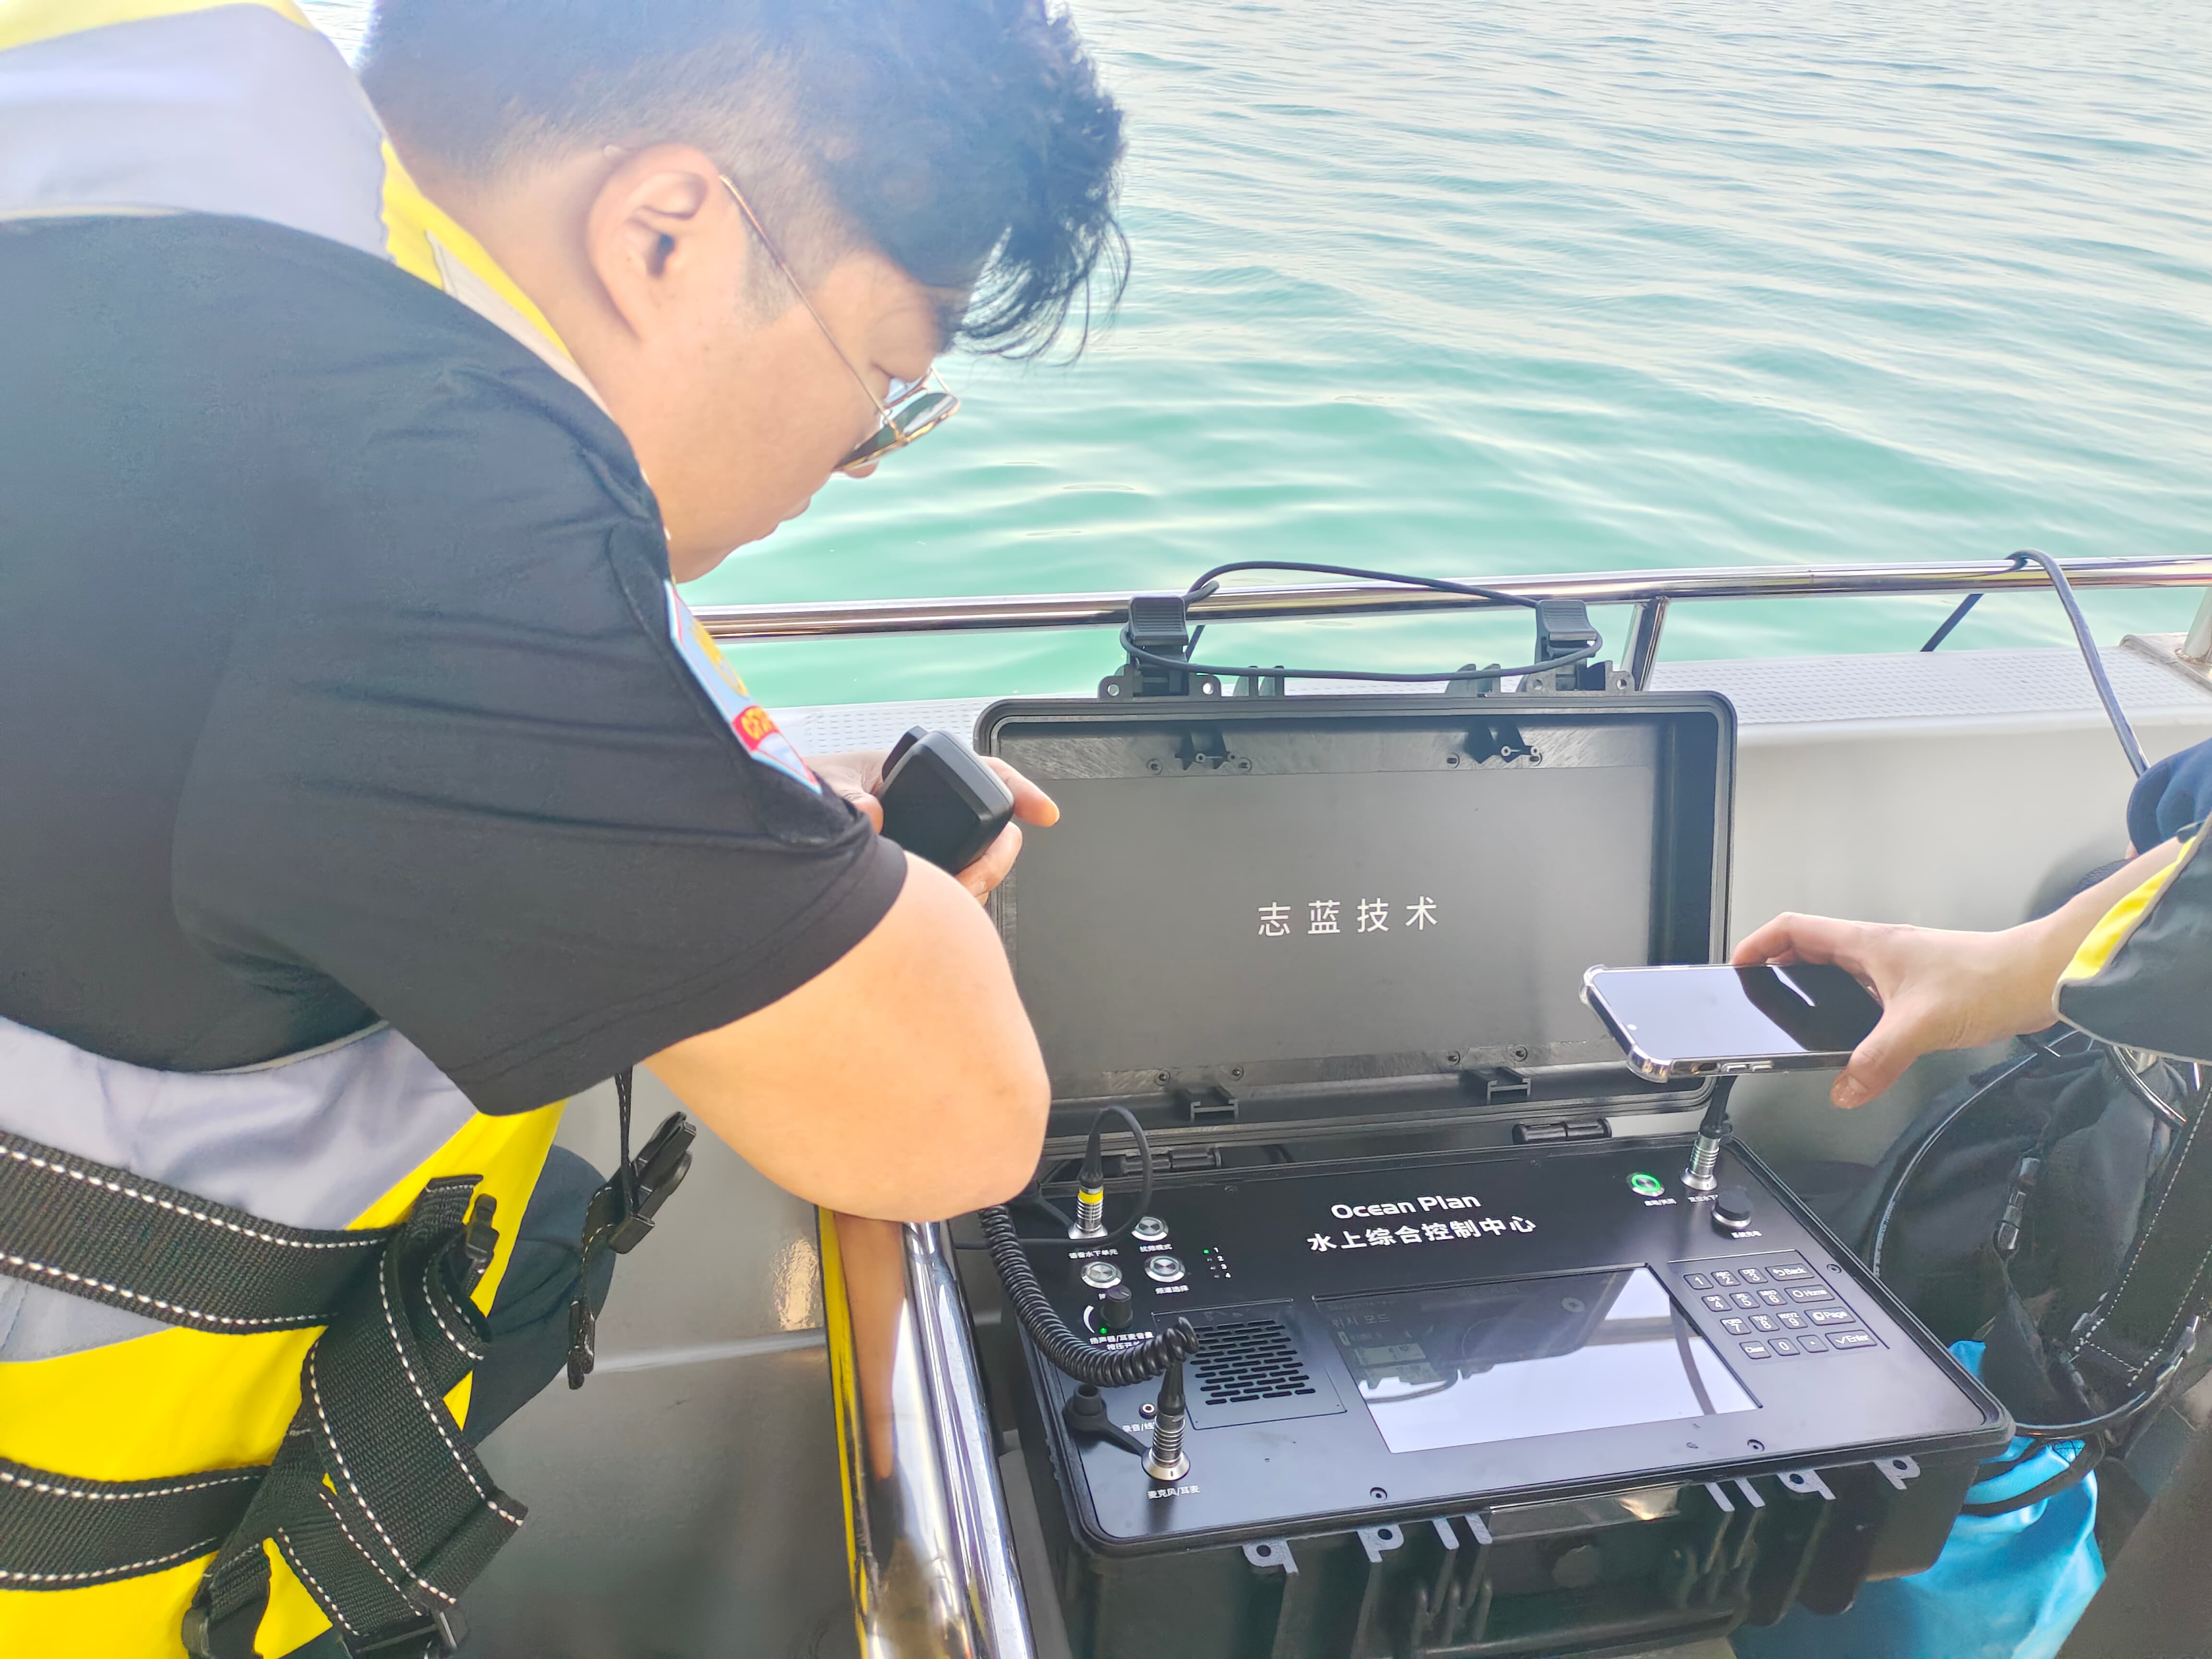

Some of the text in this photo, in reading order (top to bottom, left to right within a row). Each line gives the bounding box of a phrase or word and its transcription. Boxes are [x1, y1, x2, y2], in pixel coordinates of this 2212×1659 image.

[1258, 896, 1438, 937] 志蓝技术
[1331, 1195, 1481, 1219] Ocean Plan
[1307, 1214, 1537, 1252] 水上综合控制中心
[1783, 1267, 1808, 1275] Back
[1695, 1276, 1704, 1286] 1
[1722, 1276, 1734, 1285] 2
[1741, 1298, 1752, 1306] 5
[1768, 1294, 1780, 1303] 6
[1715, 1300, 1724, 1309] 4
[1824, 1311, 1848, 1320] Page
[1760, 1320, 1772, 1329] 8
[1788, 1318, 1800, 1327] 9
[1731, 1323, 1741, 1333] 7
[1847, 1334, 1870, 1343] Enter
[1778, 1341, 1790, 1351] 0
[1147, 1485, 1201, 1500] 麦克风/耳麦
